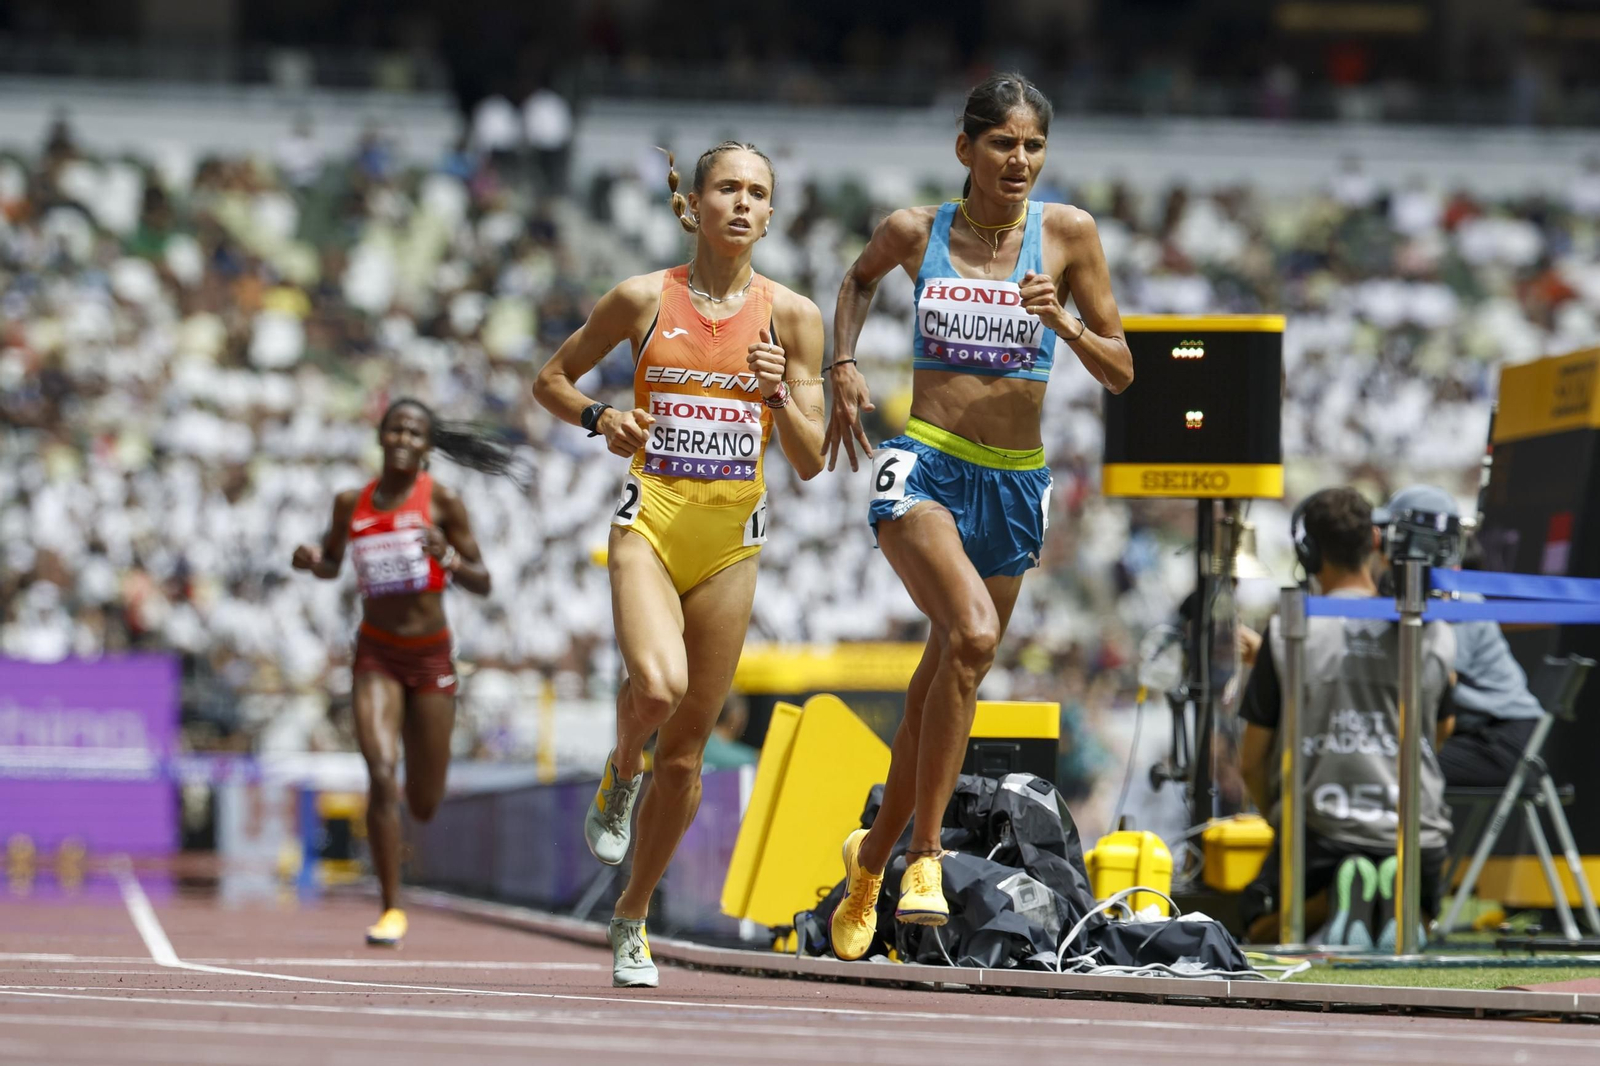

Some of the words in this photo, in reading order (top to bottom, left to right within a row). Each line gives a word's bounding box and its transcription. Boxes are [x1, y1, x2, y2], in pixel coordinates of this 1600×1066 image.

[924, 285, 1022, 306] HOND
[924, 310, 1040, 344] CHAUDHARY
[652, 400, 757, 424] HONDA
[652, 426, 755, 457] SERRANO
[876, 457, 900, 492] 6
[1141, 470, 1230, 491] SEIKO
